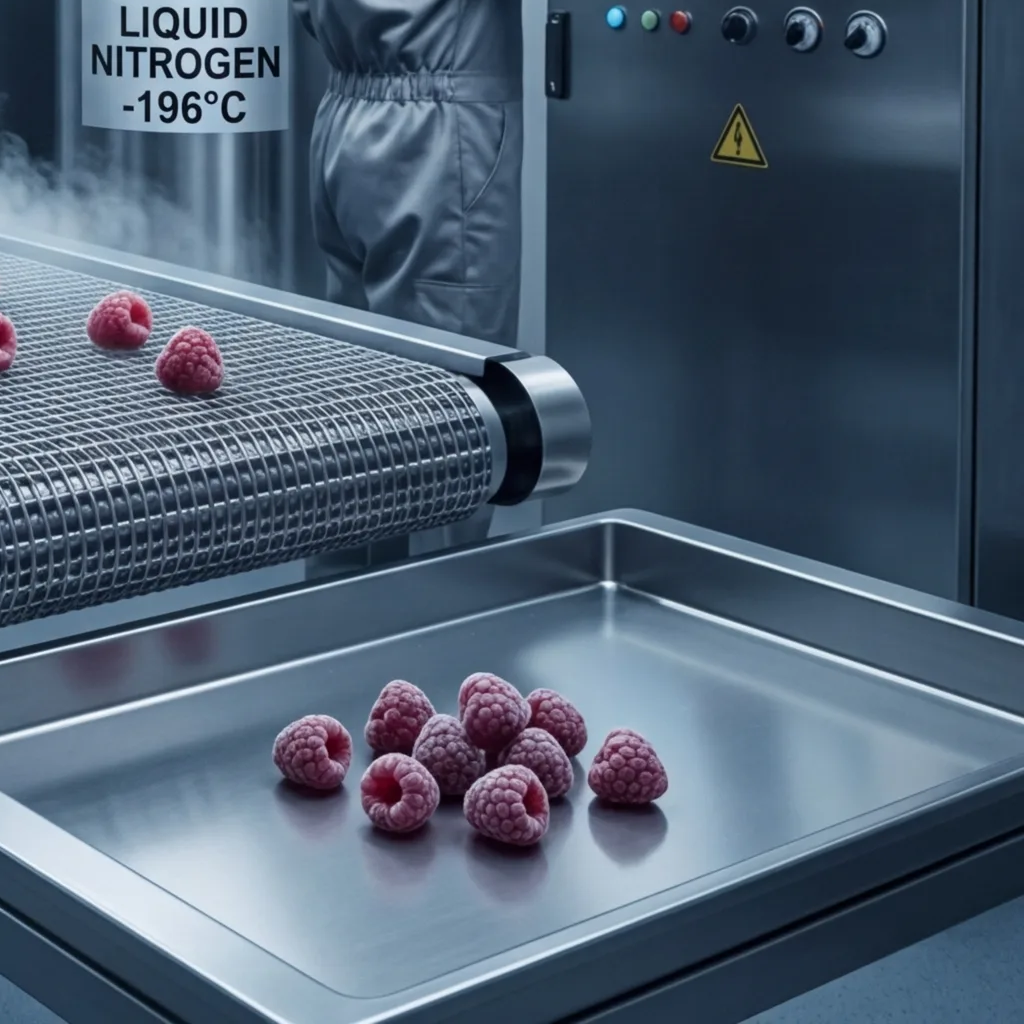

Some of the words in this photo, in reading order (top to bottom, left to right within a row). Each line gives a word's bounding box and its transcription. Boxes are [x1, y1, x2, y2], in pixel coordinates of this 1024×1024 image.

[120, 6, 248, 40] LIQUID
[92, 44, 280, 80] NITROGEN
[123, 90, 247, 124] -196°C
